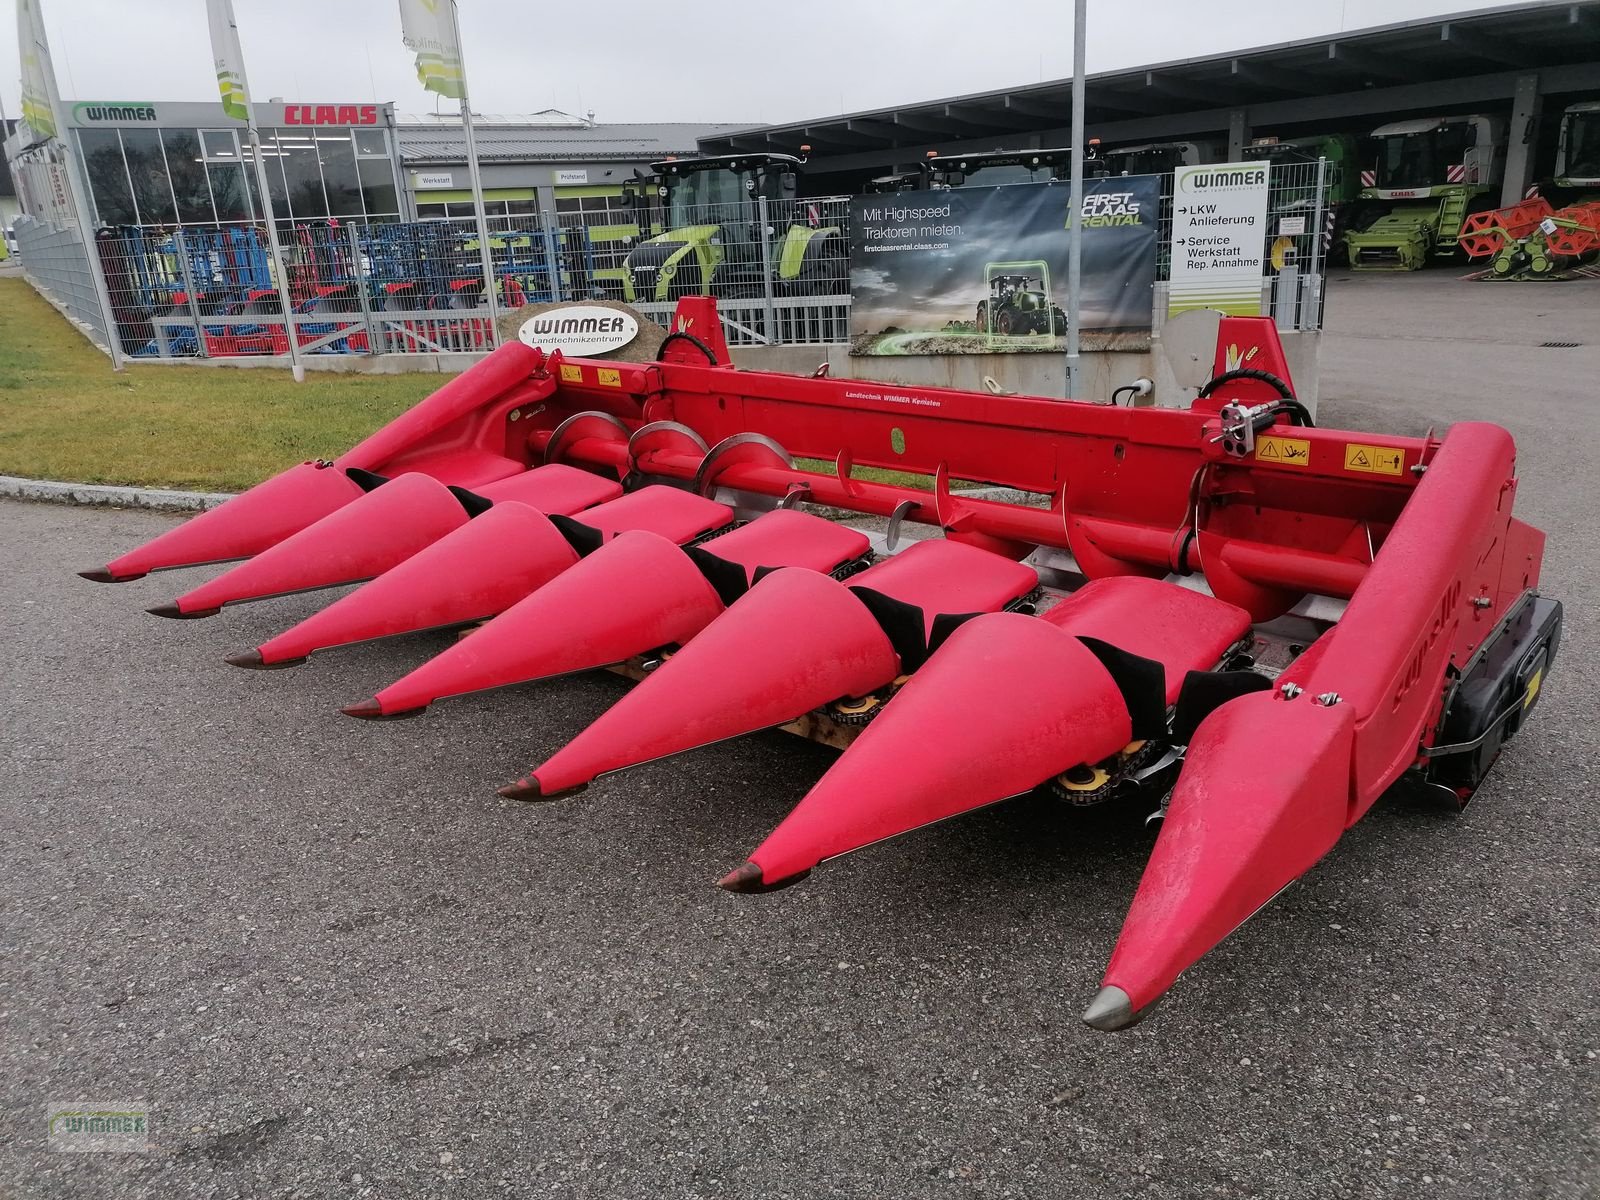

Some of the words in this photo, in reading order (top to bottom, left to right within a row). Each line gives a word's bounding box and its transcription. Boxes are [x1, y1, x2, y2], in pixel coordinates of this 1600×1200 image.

[86, 107, 157, 121] WIMMER
[285, 106, 376, 124] CLAAS
[1194, 171, 1265, 188] WIMMER
[1083, 193, 1134, 206] FIRST
[863, 208, 882, 221] Mit
[885, 204, 950, 222] Highspeed
[1081, 203, 1140, 217] CLAAS
[1190, 205, 1217, 214] LKW
[1080, 214, 1142, 228] RENTAL
[1189, 216, 1255, 227] Anlieferung
[864, 227, 917, 240] Traktoren
[920, 224, 964, 237] mieten.
[864, 242, 949, 252] firstclaasrental.claas.com
[1188, 236, 1230, 246] Service
[1188, 247, 1240, 257] Werkstatt
[1187, 259, 1209, 270] Rep.
[1212, 258, 1259, 268] Annahme
[534, 317, 625, 334] WIMMER
[532, 336, 623, 344] Landtechnikzentrum
[846, 391, 881, 401] Landtechnik
[884, 395, 910, 404] WIMMER
